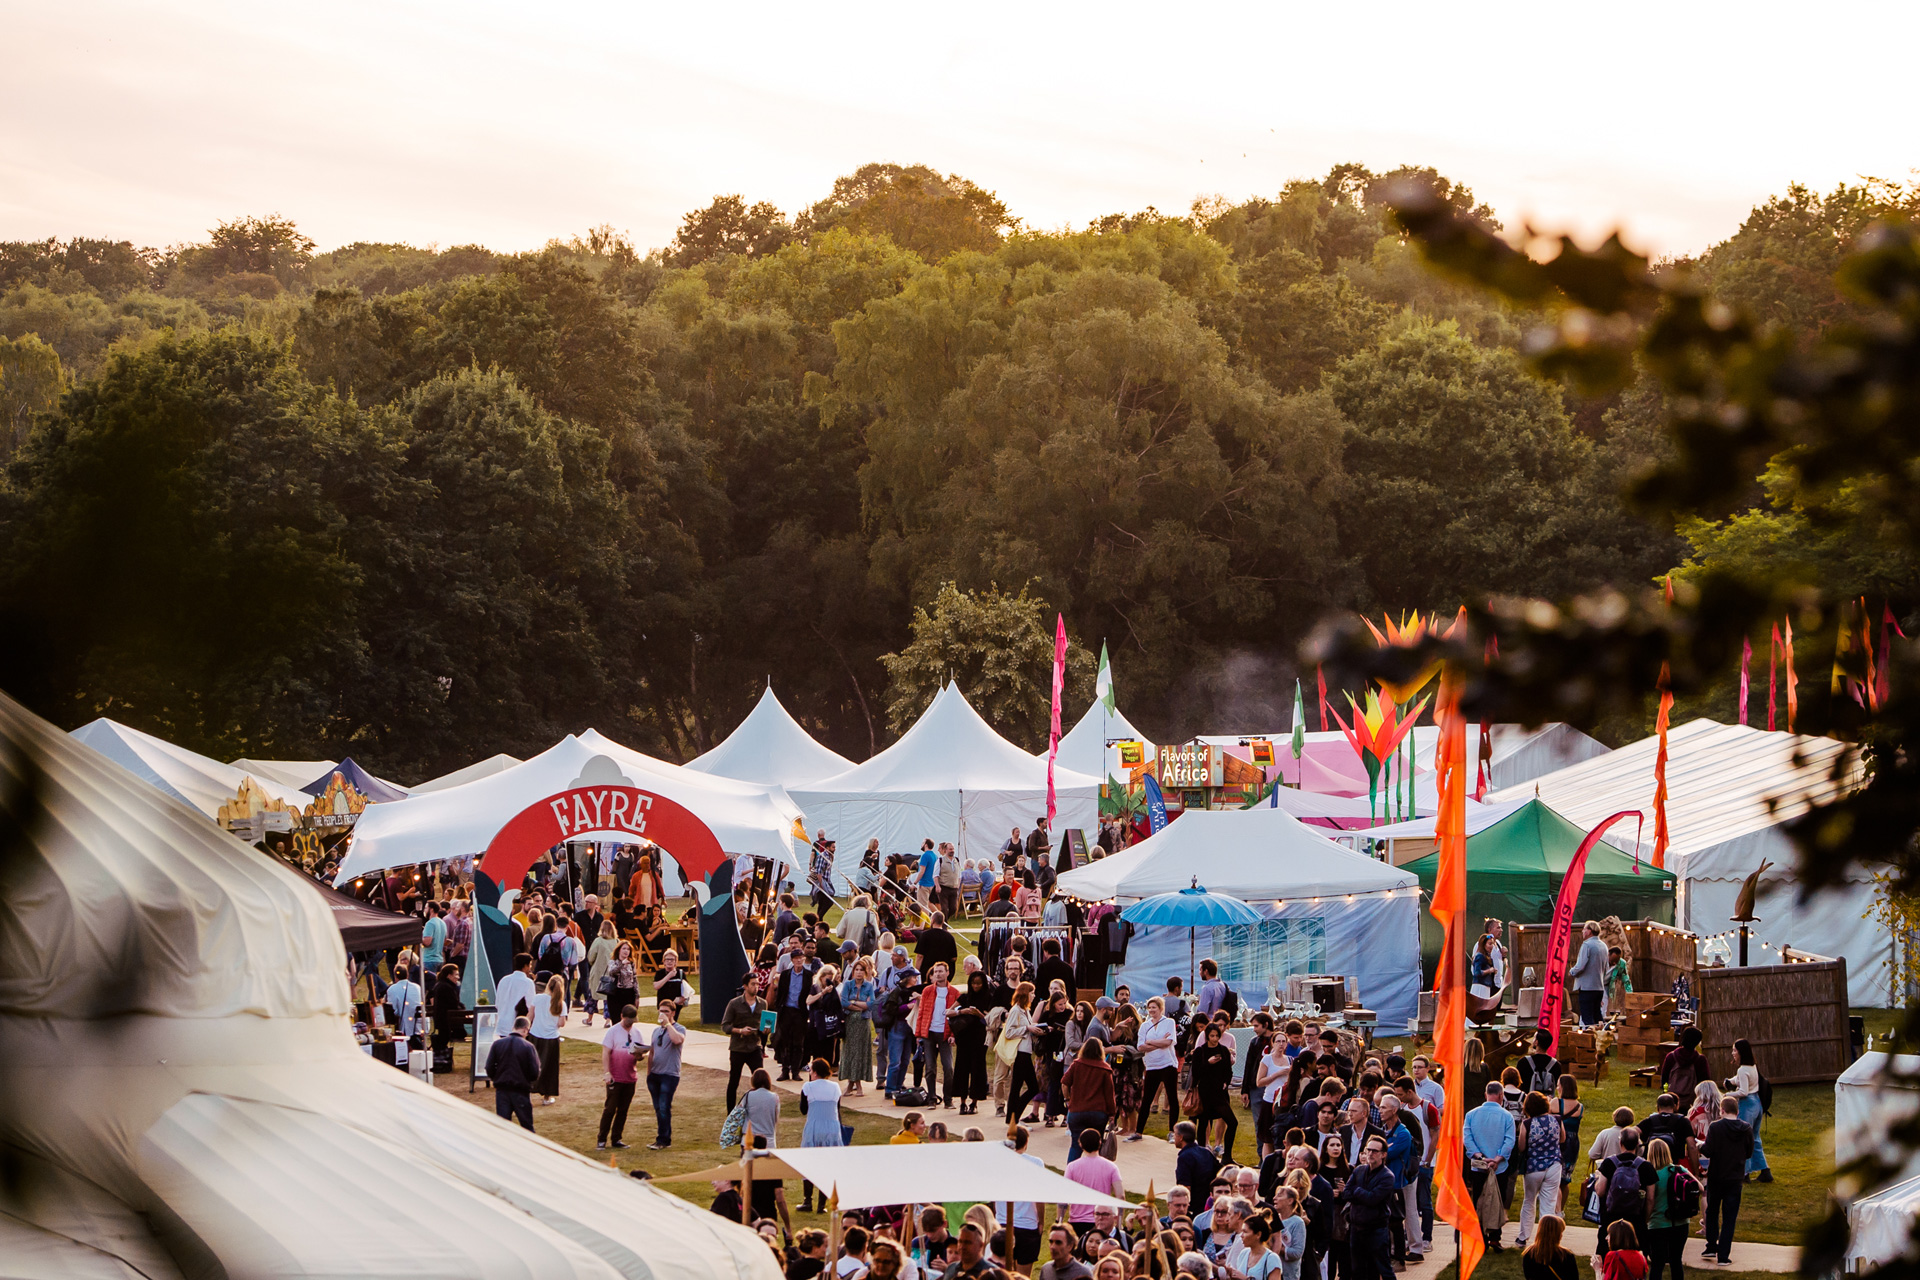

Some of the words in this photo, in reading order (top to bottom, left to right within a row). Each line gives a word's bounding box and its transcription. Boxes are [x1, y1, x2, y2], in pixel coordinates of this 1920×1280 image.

[1160, 748, 1197, 762] Flavors
[1198, 748, 1209, 762] of
[1162, 762, 1209, 782] Africa
[313, 816, 323, 827] THE
[550, 790, 653, 836] FAYRE
